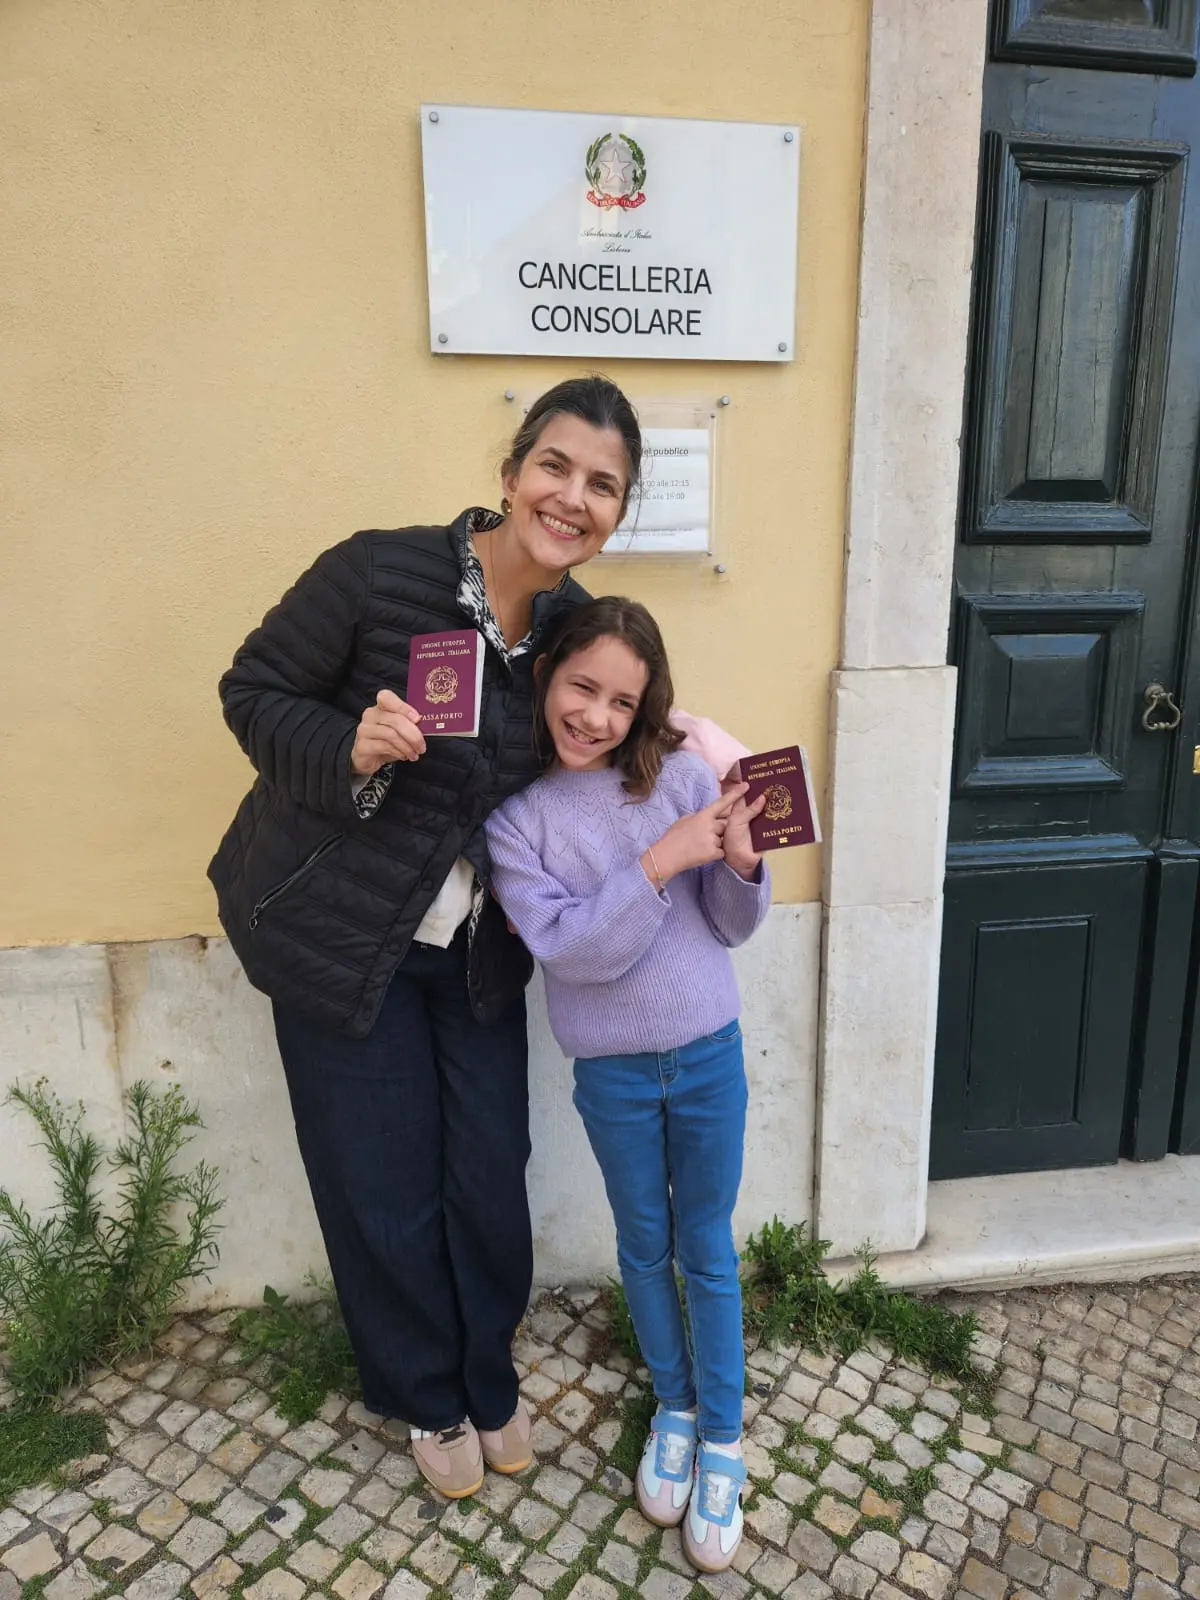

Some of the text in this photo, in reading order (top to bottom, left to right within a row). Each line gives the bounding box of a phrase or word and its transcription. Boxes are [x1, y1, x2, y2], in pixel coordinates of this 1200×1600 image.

[518, 261, 712, 295] CANCELLERIA
[531, 304, 702, 336] CONSOLARE
[653, 447, 689, 457] pubblico
[656, 479, 669, 487] alle
[421, 639, 466, 649] UNIONE EUROPEA
[416, 648, 471, 660] REPUBBLICA ITALIANA
[750, 756, 791, 771] UNIONE EUROPEA
[748, 765, 797, 781] REPUBBLICA ITALIANA
[762, 825, 802, 838] PASSAPORTO
